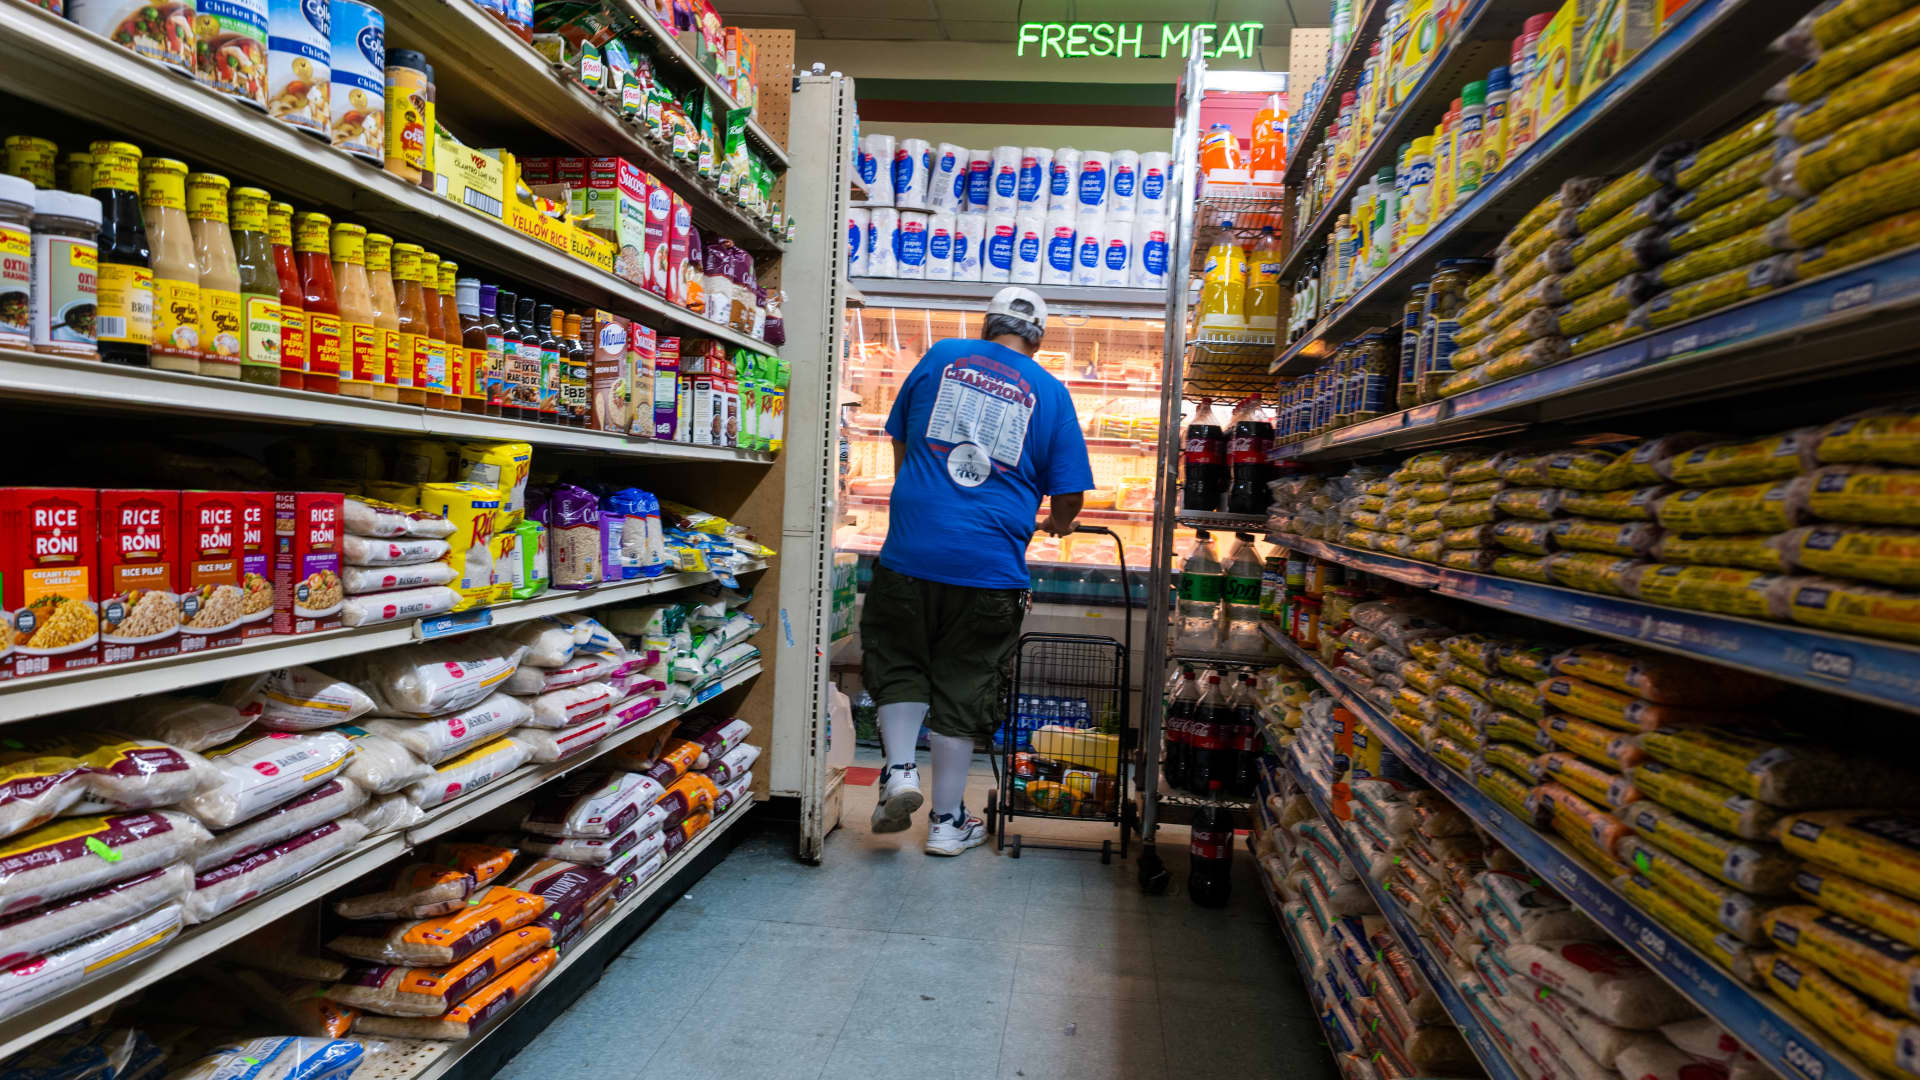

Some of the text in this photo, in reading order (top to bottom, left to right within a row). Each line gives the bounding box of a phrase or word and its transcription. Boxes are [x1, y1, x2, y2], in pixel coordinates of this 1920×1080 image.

[205, 1, 250, 21] Chicken
[1018, 23, 1264, 58] FRESH MEAT
[512, 213, 568, 249] YELLOW RICE
[904, 241, 921, 249] paper
[597, 253, 612, 269] RICE
[325, 338, 339, 347] HOT
[945, 367, 1033, 409] CHAMPIONS
[35, 509, 77, 526] RICE
[122, 509, 160, 526] RICE
[201, 509, 232, 525] RICE
[244, 508, 261, 522] CE
[311, 508, 334, 522] RICE
[36, 535, 77, 554] RONI
[122, 534, 160, 551] RONI
[201, 533, 231, 548] RONI
[311, 530, 334, 543] RONI
[121, 567, 163, 577] RICE PILAF
[198, 562, 232, 572] RICE PILAF
[1640, 927, 1666, 954] GOYA
[1786, 1040, 1825, 1080] GOYA
